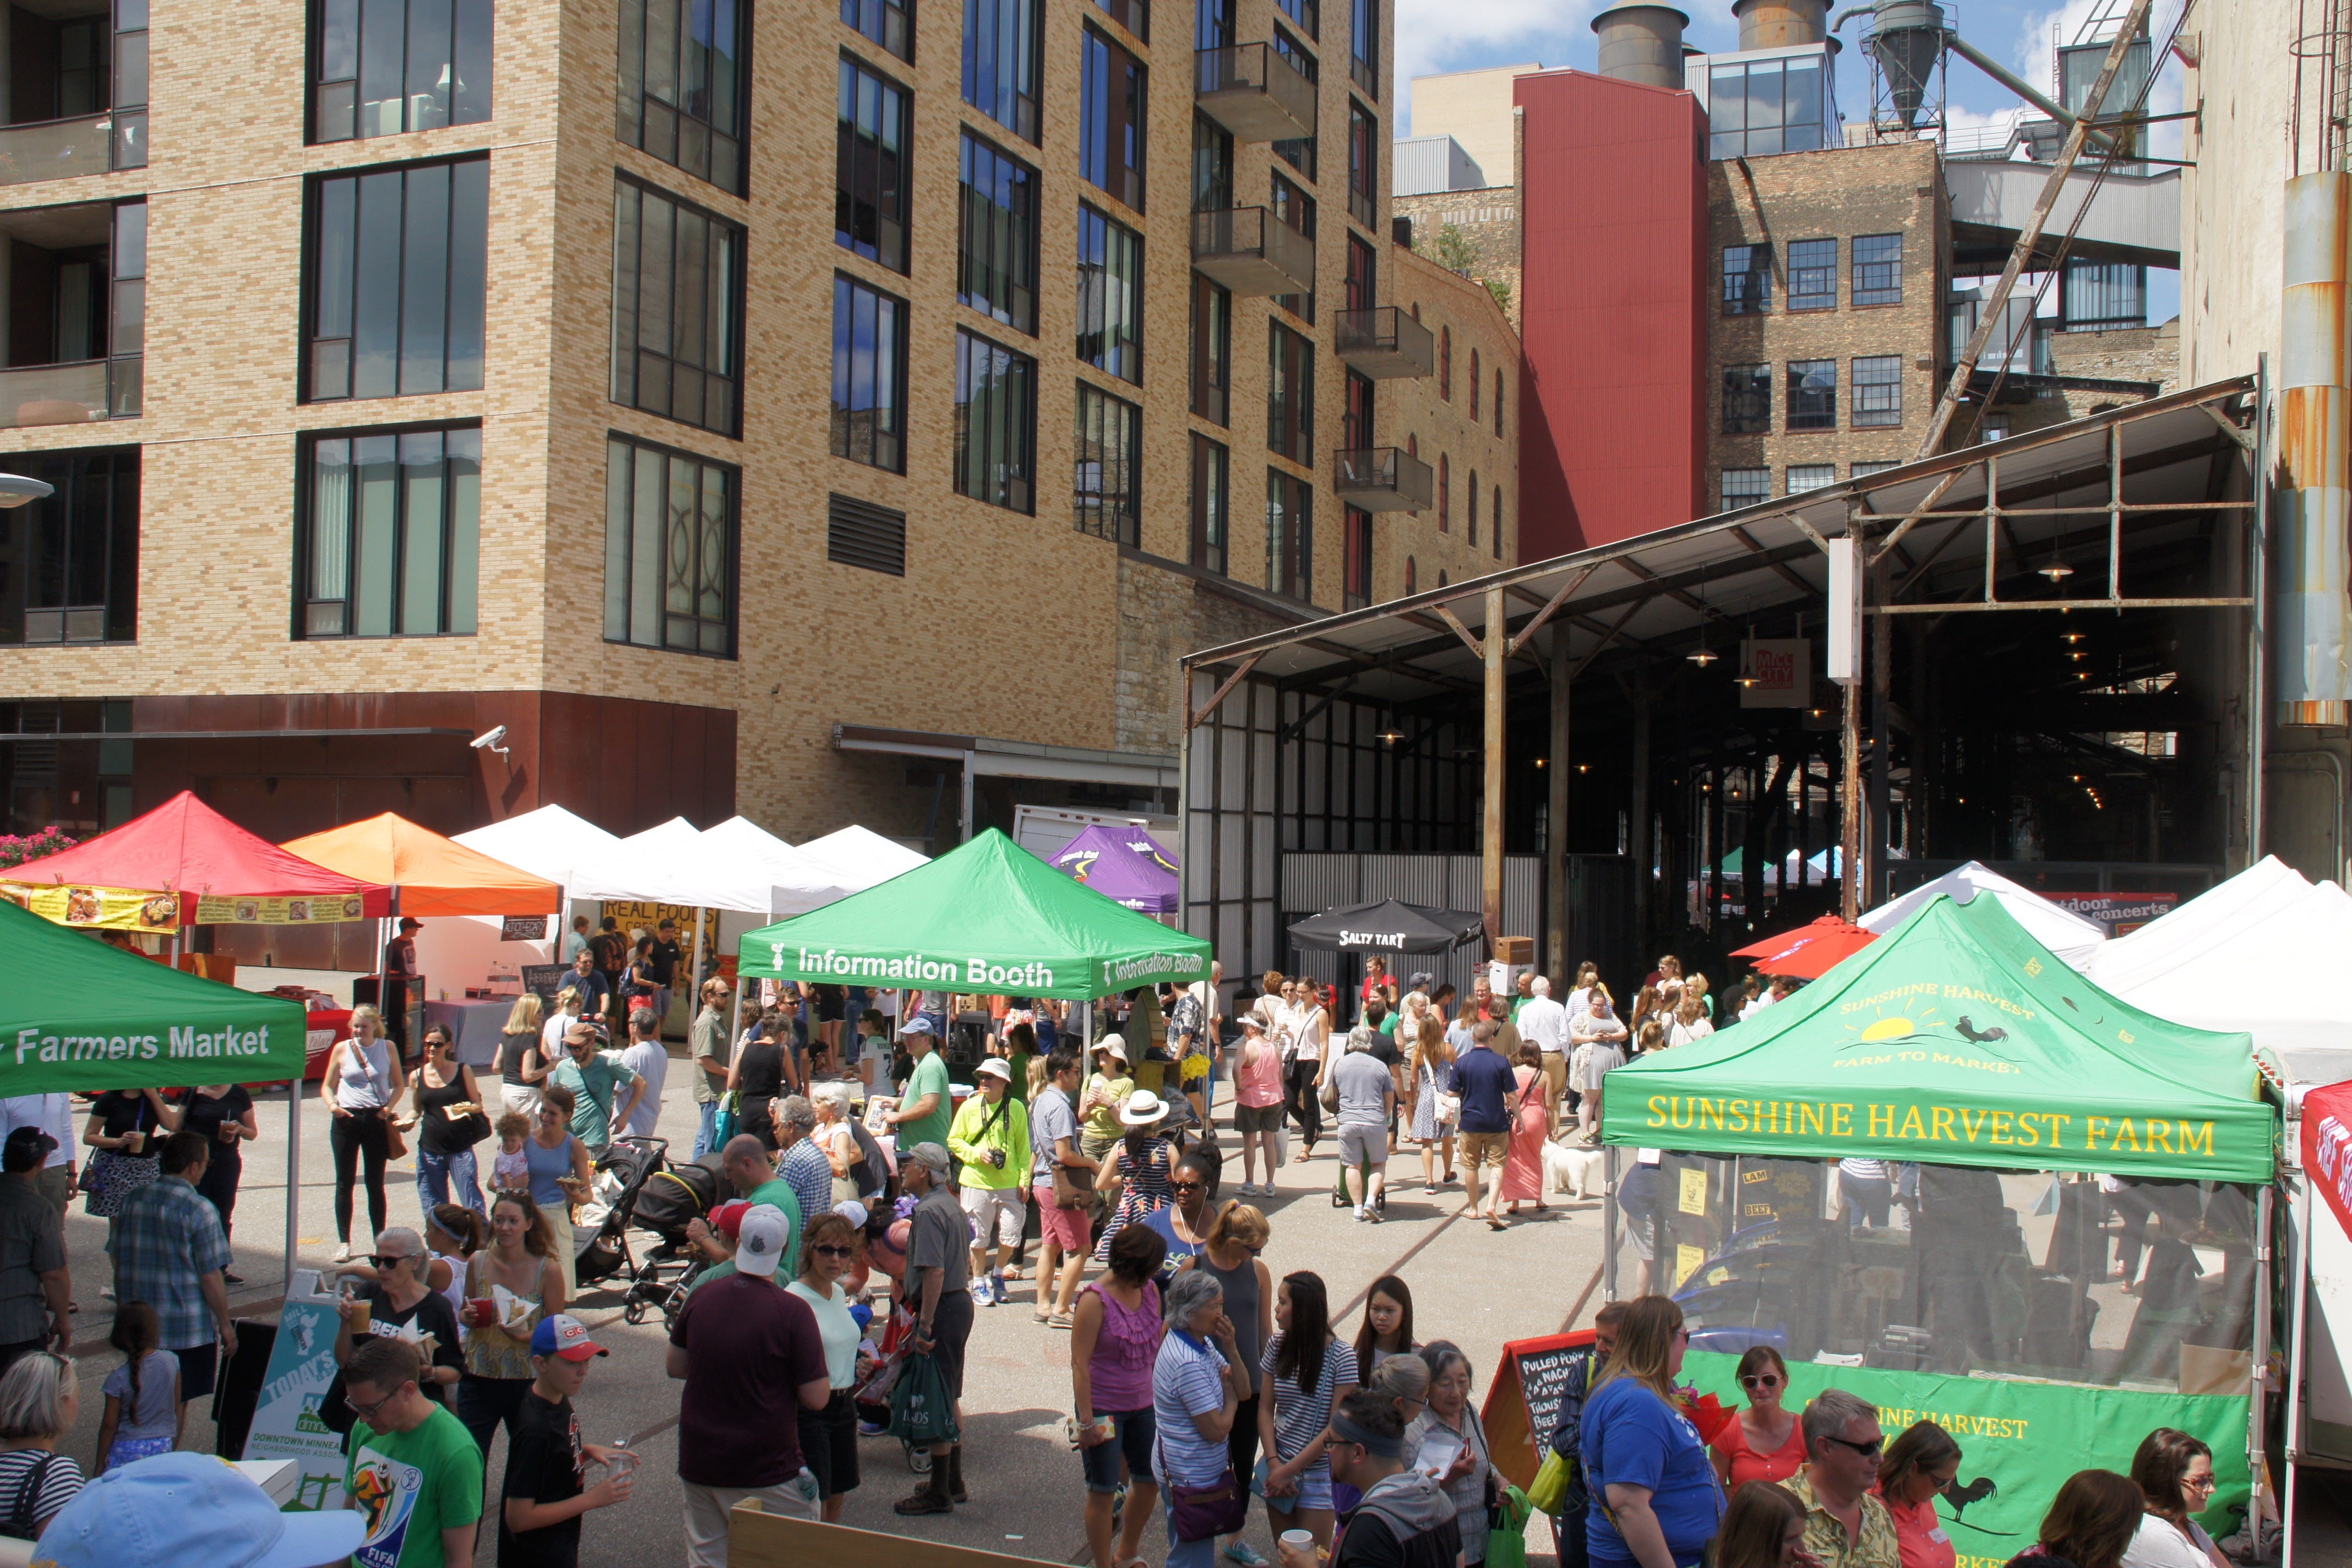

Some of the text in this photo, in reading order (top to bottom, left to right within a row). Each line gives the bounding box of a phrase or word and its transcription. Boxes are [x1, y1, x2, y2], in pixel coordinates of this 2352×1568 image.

[1757, 652, 1793, 666] MILL
[1758, 667, 1790, 680] CITY
[1757, 680, 1793, 689] MUSEUM
[605, 901, 652, 919] REAL
[2060, 898, 2111, 912] tdoor
[2092, 902, 2169, 921] concerts
[1339, 930, 1406, 949] SALTY TART
[799, 947, 1053, 987] Information Booth
[1115, 951, 1203, 981] Information Booth
[1841, 983, 2035, 1020] SUNSHINE HARVEST
[17, 1025, 269, 1064] Farmers Market
[1833, 1051, 2022, 1074] FARM TO MARKET
[1647, 1096, 2215, 1156] SUNSHINE HARVEST FARM
[1745, 1205, 1771, 1215] BEEF
[284, 1305, 308, 1322] MILL
[1522, 1351, 1585, 1375] PULLED PORK
[265, 1349, 335, 1402] TODAY'S
[1533, 1413, 1558, 1430] BEEF
[251, 1442, 312, 1455] NEIGHBORHOOD
[253, 1433, 340, 1450] DOWNTOWN MINNEA
[361, 1556, 380, 1568] WORLD
[368, 1547, 395, 1566] FIFA
